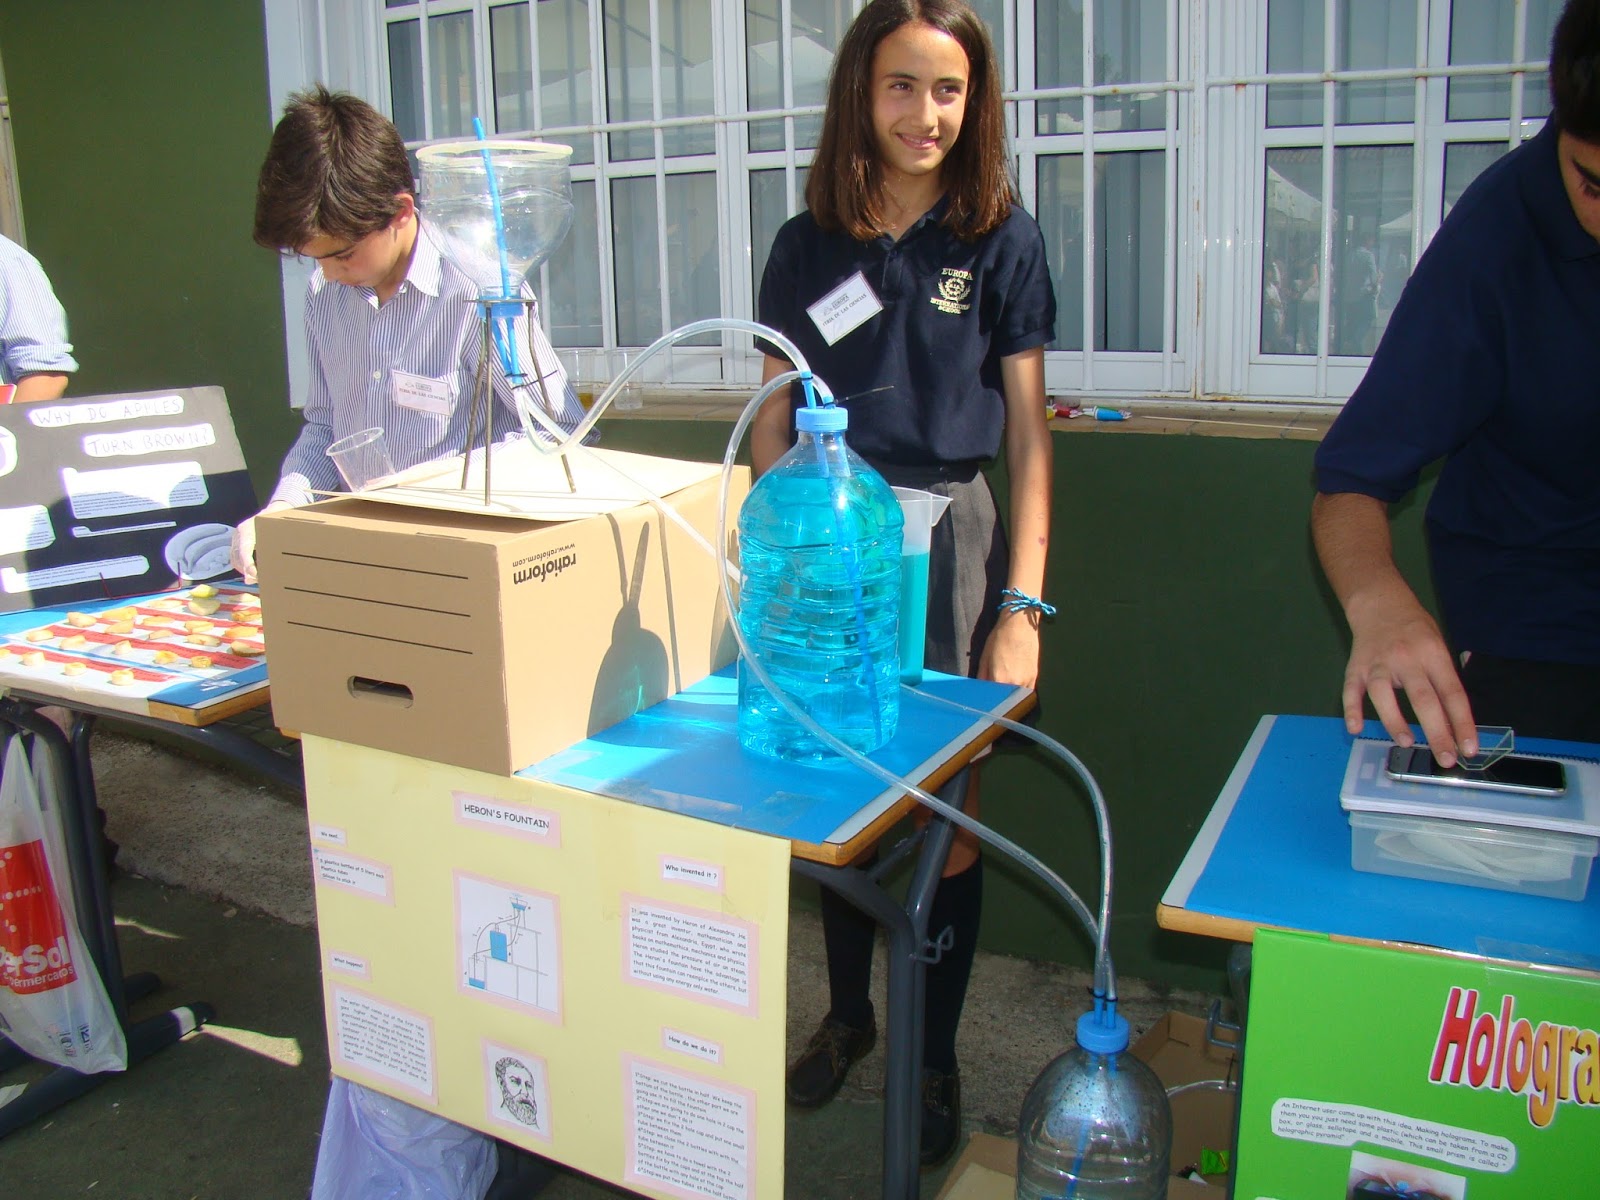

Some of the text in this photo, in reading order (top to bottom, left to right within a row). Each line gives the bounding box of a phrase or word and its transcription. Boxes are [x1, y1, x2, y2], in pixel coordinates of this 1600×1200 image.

[941, 268, 973, 280] EUROPA
[35, 410, 71, 424] WHY
[124, 398, 181, 418] APPLES
[88, 440, 134, 456] TURN
[512, 543, 576, 568] www.ratioform.com
[514, 553, 576, 585] ratioform
[464, 804, 549, 828] HERON'S FOUNTAIN
[680, 867, 705, 877] invented
[668, 1035, 680, 1044] How
[709, 1048, 717, 1056] it?
[1277, 1126, 1314, 1136] holographic
[1292, 1104, 1320, 1112] Internet
[1383, 1117, 1396, 1125] this
[1415, 1125, 1440, 1136] Making
[1490, 1144, 1509, 1152] make
[1327, 1125, 1357, 1135] sellotape
[1408, 1141, 1423, 1149] This
[1446, 1151, 1466, 1159] prism
[1478, 1159, 1499, 1167] called
[1376, 1126, 1399, 1135] plastic
[1450, 1142, 1469, 1151] taken
[1471, 1147, 1488, 1156] from
